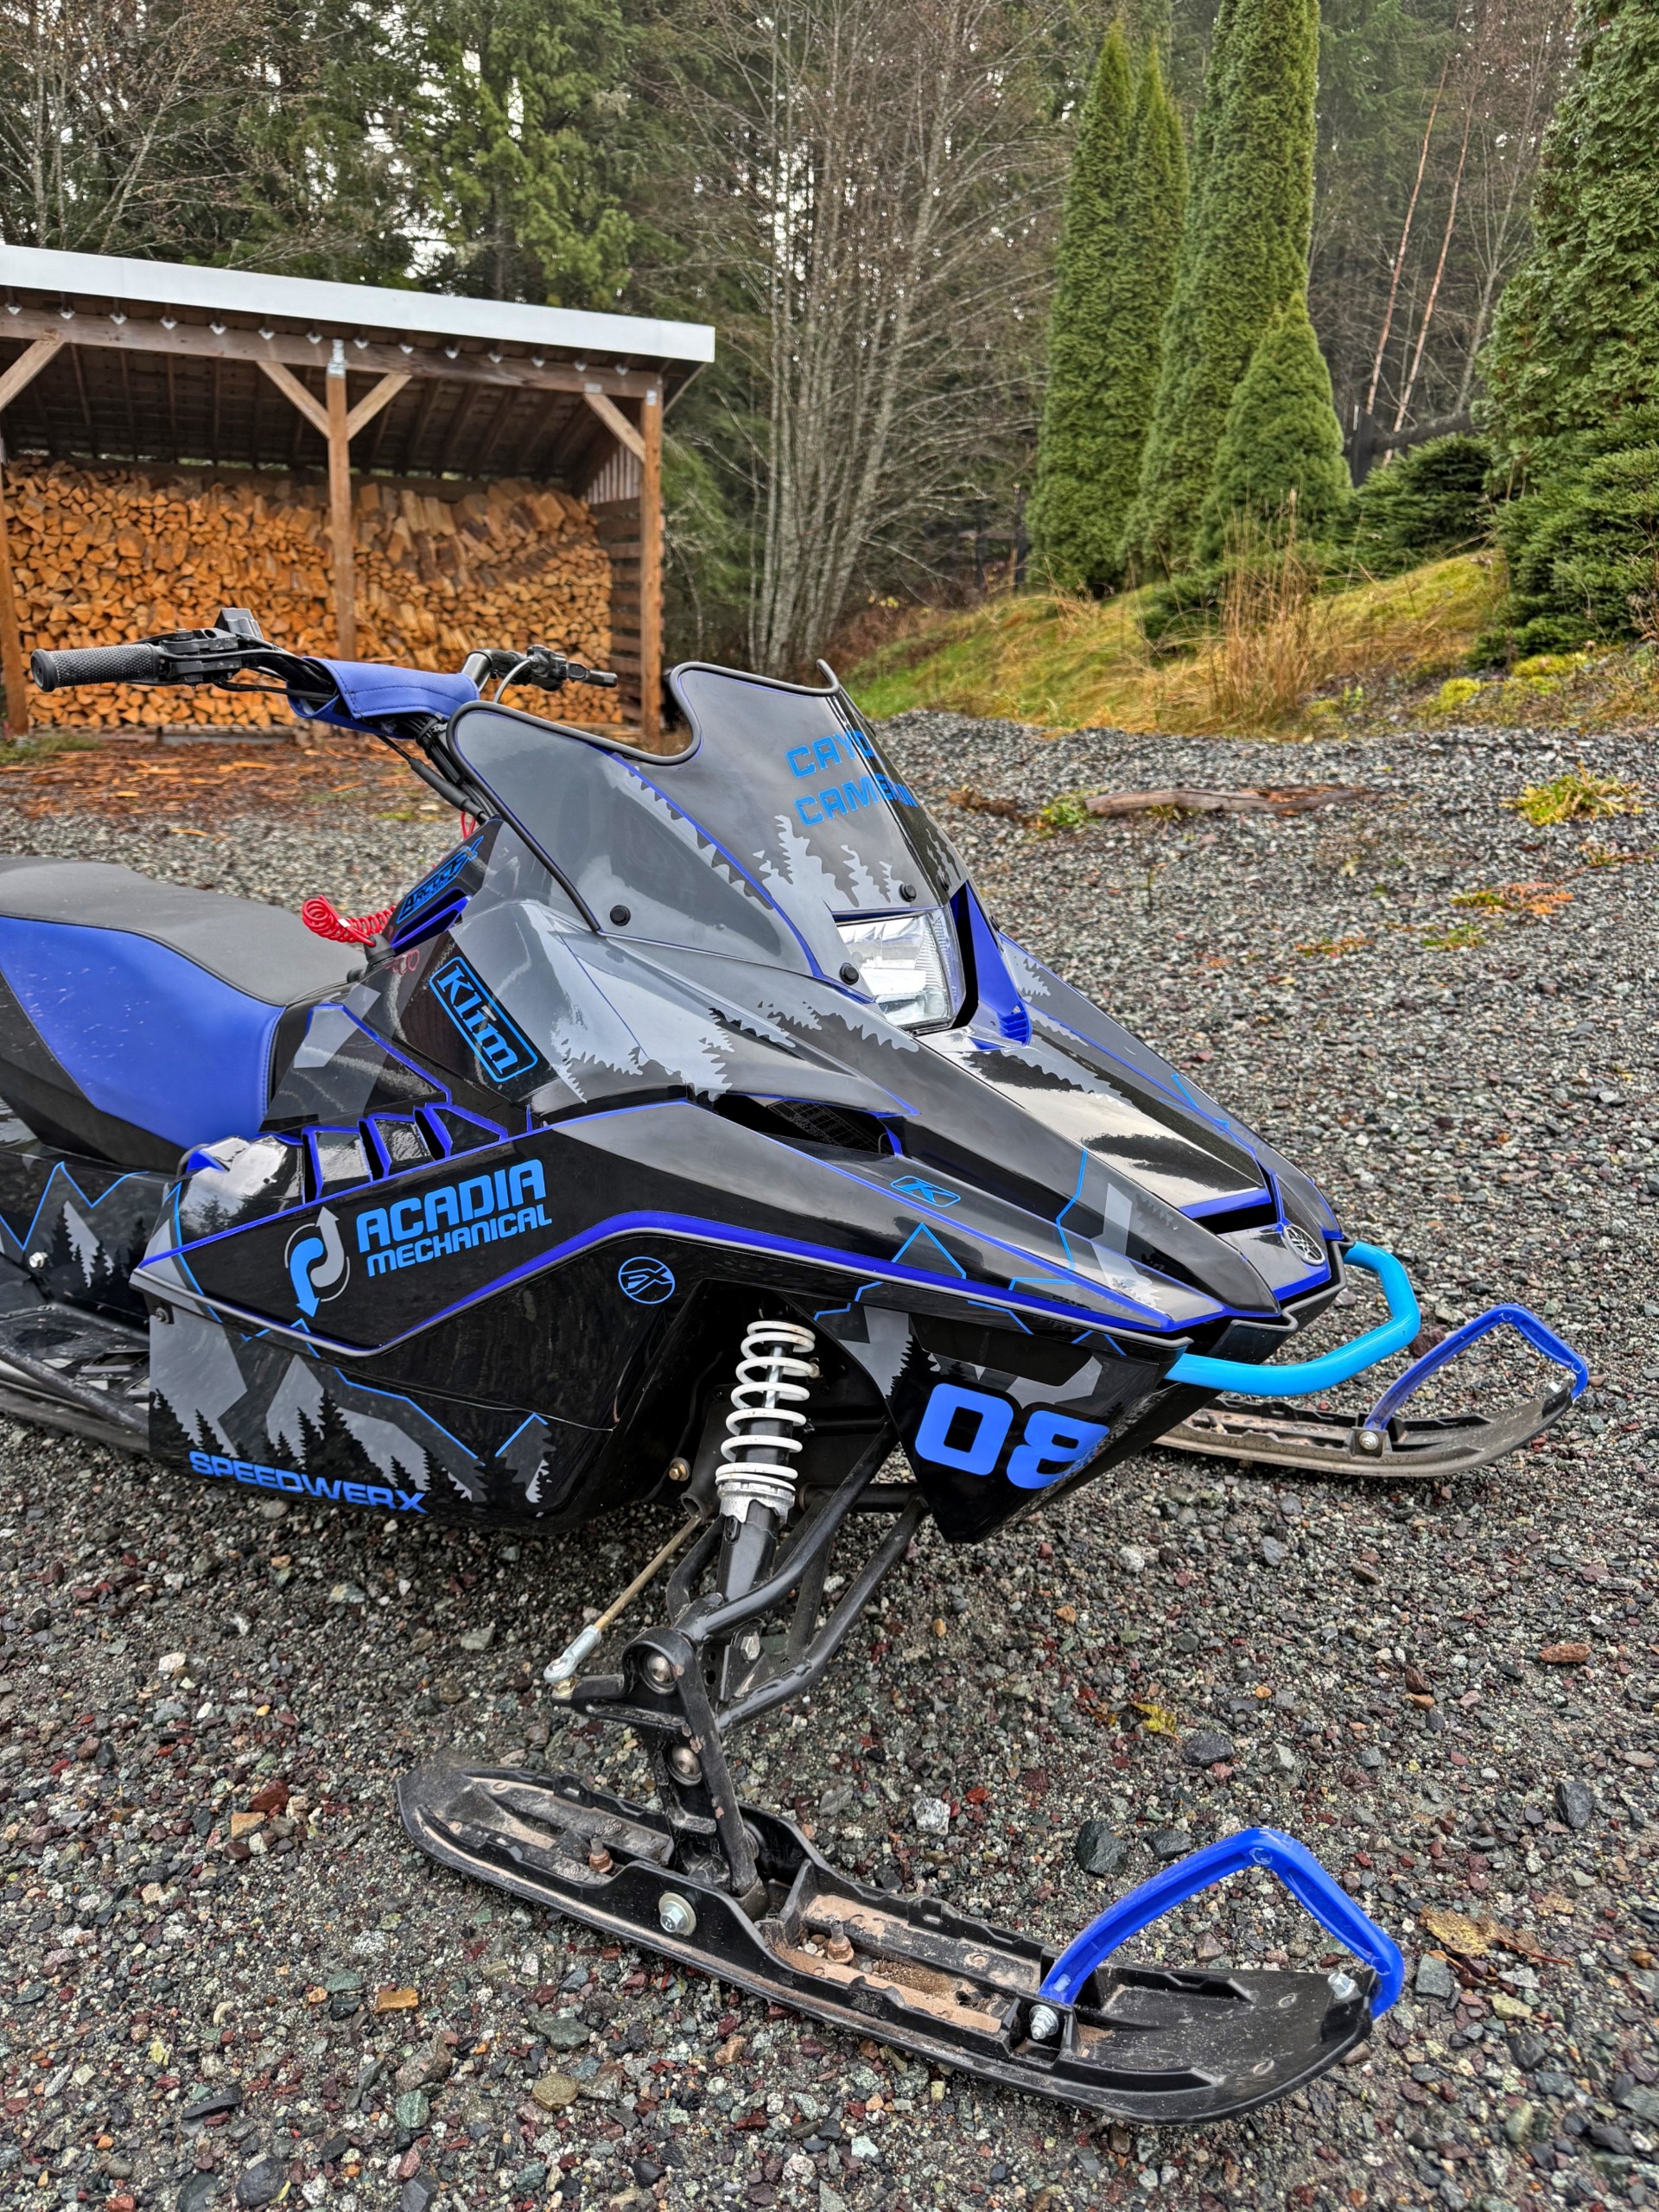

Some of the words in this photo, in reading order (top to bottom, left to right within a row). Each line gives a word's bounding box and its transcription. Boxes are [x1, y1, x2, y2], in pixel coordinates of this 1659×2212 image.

[356, 1159, 546, 1253] ACADIA
[366, 1204, 552, 1277] MECHANICAL
[914, 1382, 1109, 1490] 08
[188, 1451, 429, 1514] SPEEDWERX
